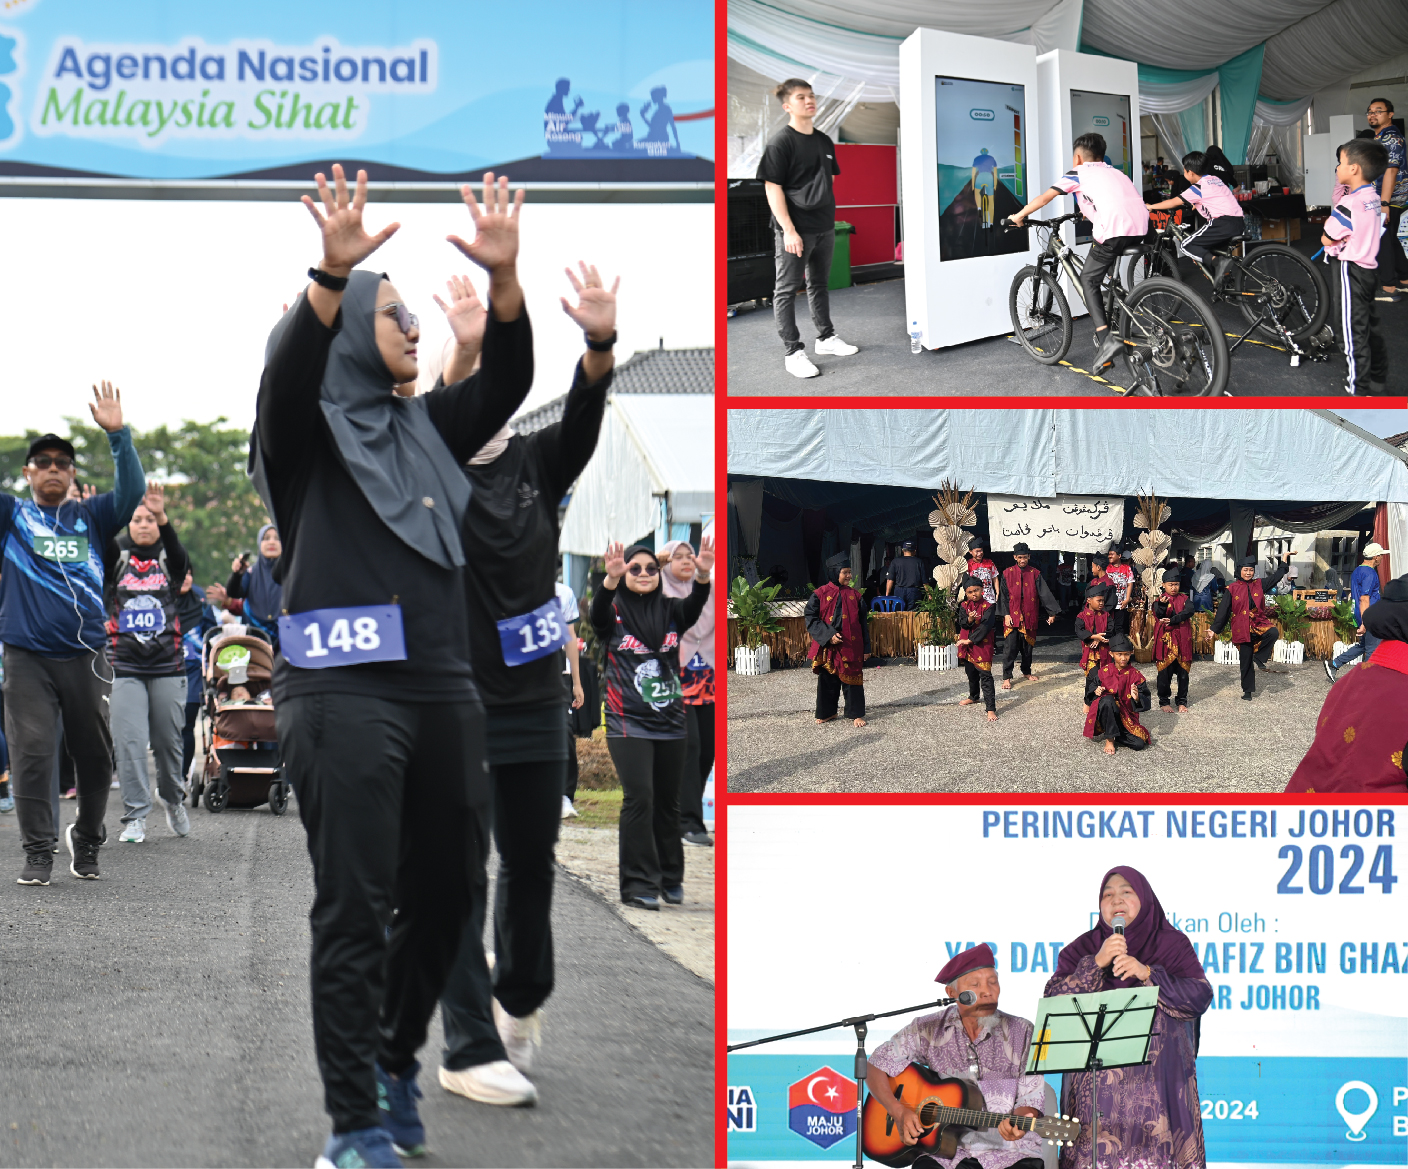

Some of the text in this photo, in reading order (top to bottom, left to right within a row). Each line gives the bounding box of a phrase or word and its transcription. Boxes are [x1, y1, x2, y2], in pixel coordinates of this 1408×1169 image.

[54, 45, 428, 91] Agenda Nasional
[41, 87, 359, 137] Malaysia Sihat
[44, 541, 78, 558] 265
[126, 613, 155, 628] 140
[518, 611, 561, 653] 135
[304, 617, 380, 657] 148
[983, 809, 1395, 838] PERINGKAT NEGERI JOHOR
[1277, 844, 1398, 895] 2024
[1218, 912, 1266, 933] Oleh
[1275, 942, 1326, 973] BIN
[1240, 985, 1320, 1010] JOHOR
[807, 1116, 843, 1127] MAJU
[1200, 1100, 1259, 1120] 2024
[806, 1126, 844, 1135] JOHOR
